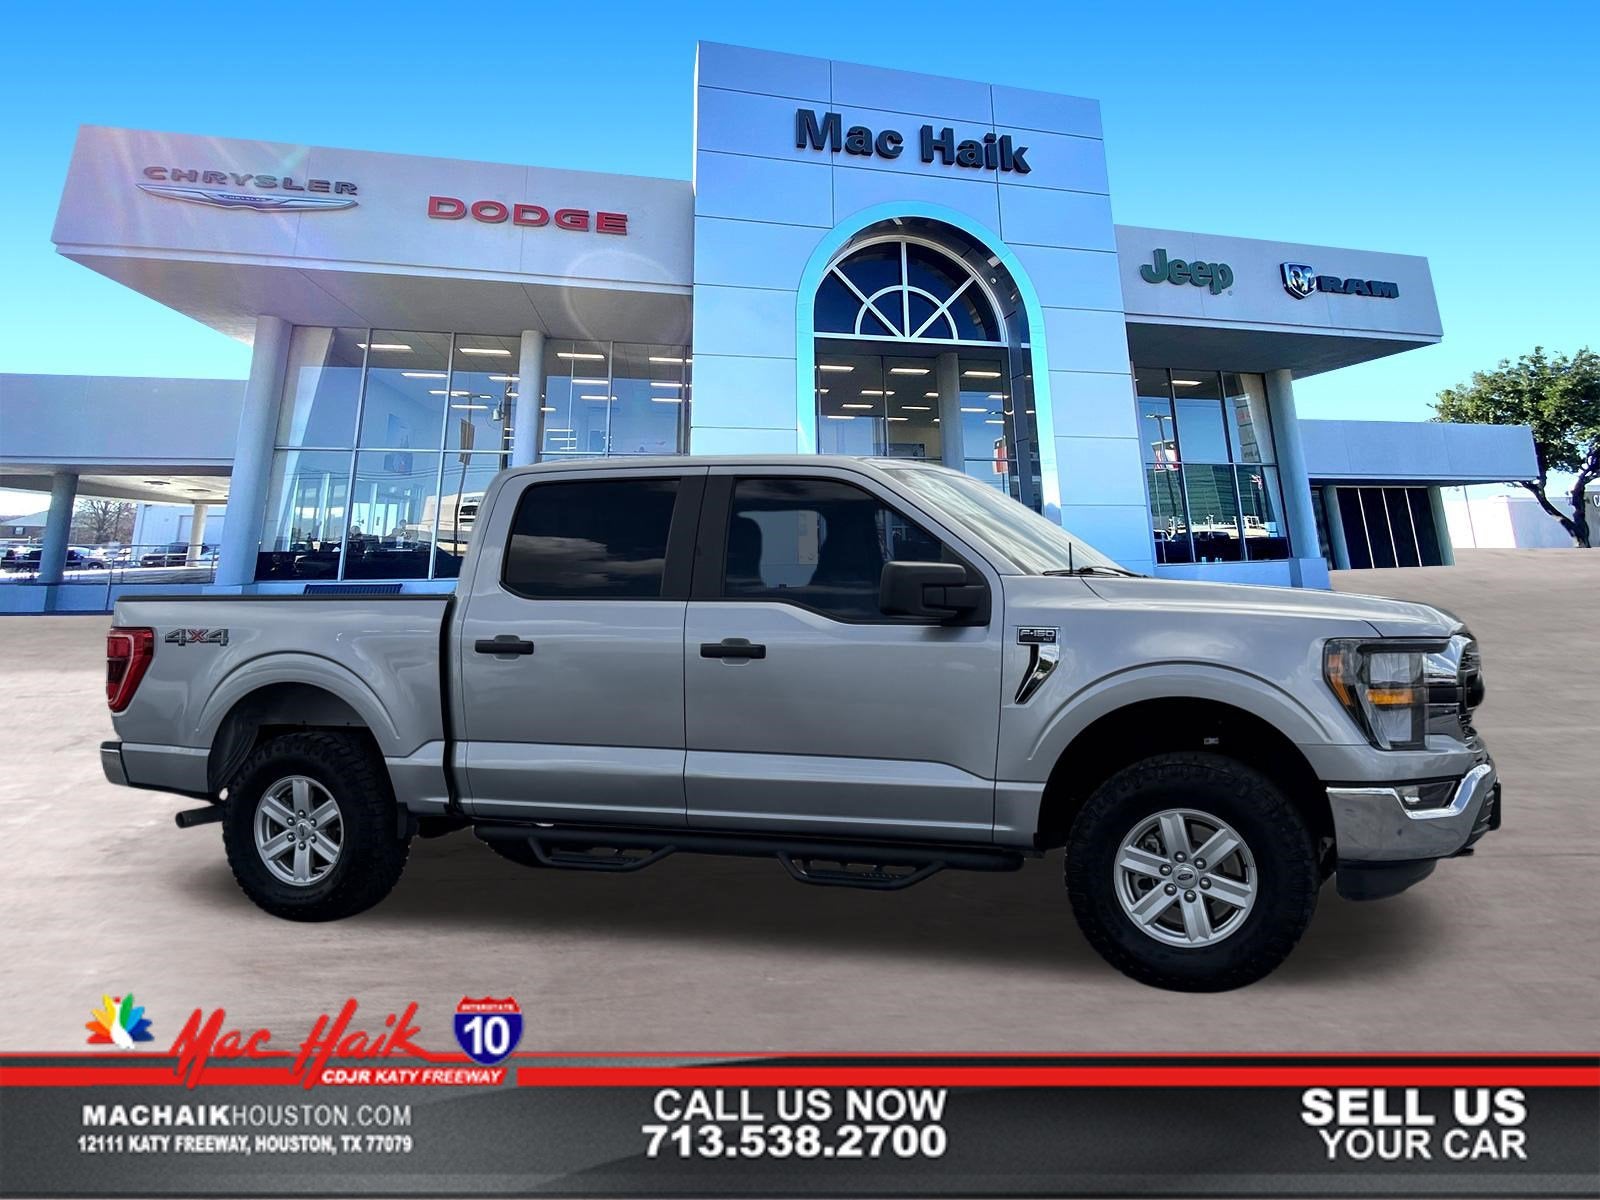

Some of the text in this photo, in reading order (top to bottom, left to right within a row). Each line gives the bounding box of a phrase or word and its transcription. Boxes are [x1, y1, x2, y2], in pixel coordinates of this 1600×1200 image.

[796, 108, 1032, 174] Mac Haik
[143, 166, 358, 196] CHRYSLER
[428, 196, 628, 236] DODGE
[1140, 248, 1234, 295] Jeep
[1316, 275, 1400, 299] RAM
